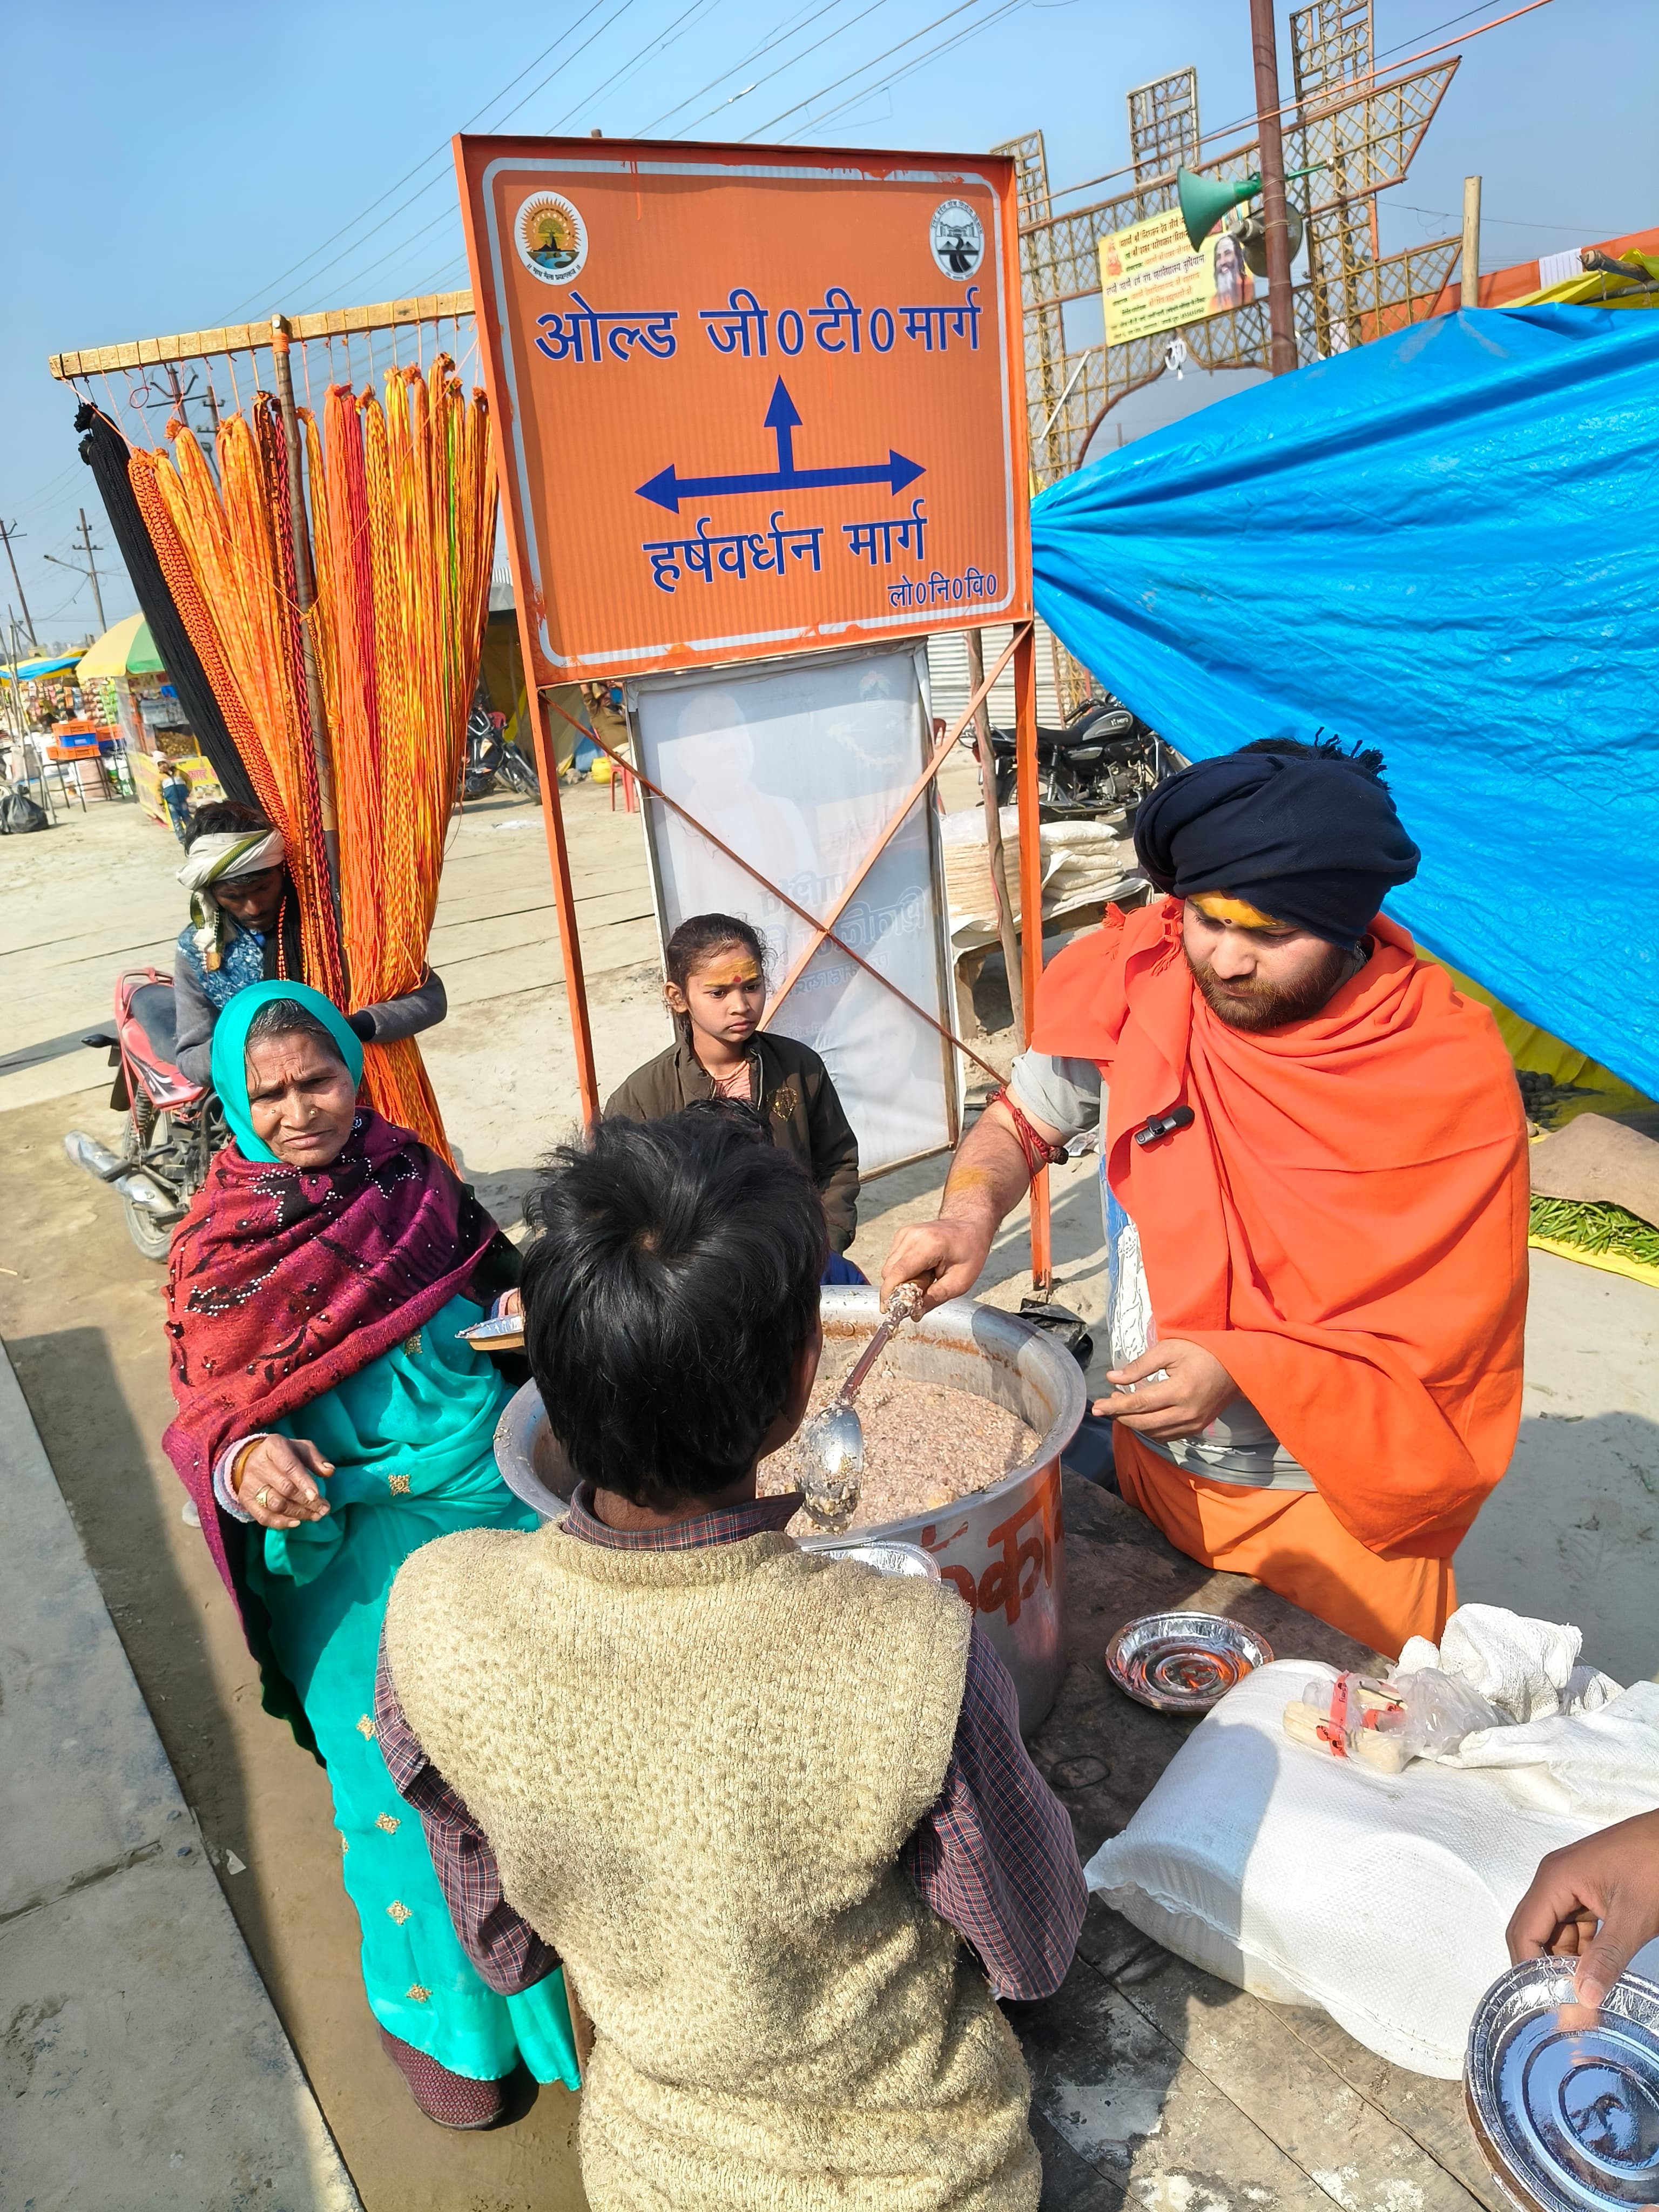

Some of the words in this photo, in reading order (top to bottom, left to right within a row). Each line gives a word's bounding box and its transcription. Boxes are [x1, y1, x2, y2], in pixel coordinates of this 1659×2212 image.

[536, 292, 678, 362] ओल्ड
[643, 510, 824, 592] हर्षवर्धन
[842, 498, 927, 565] मार्ग
